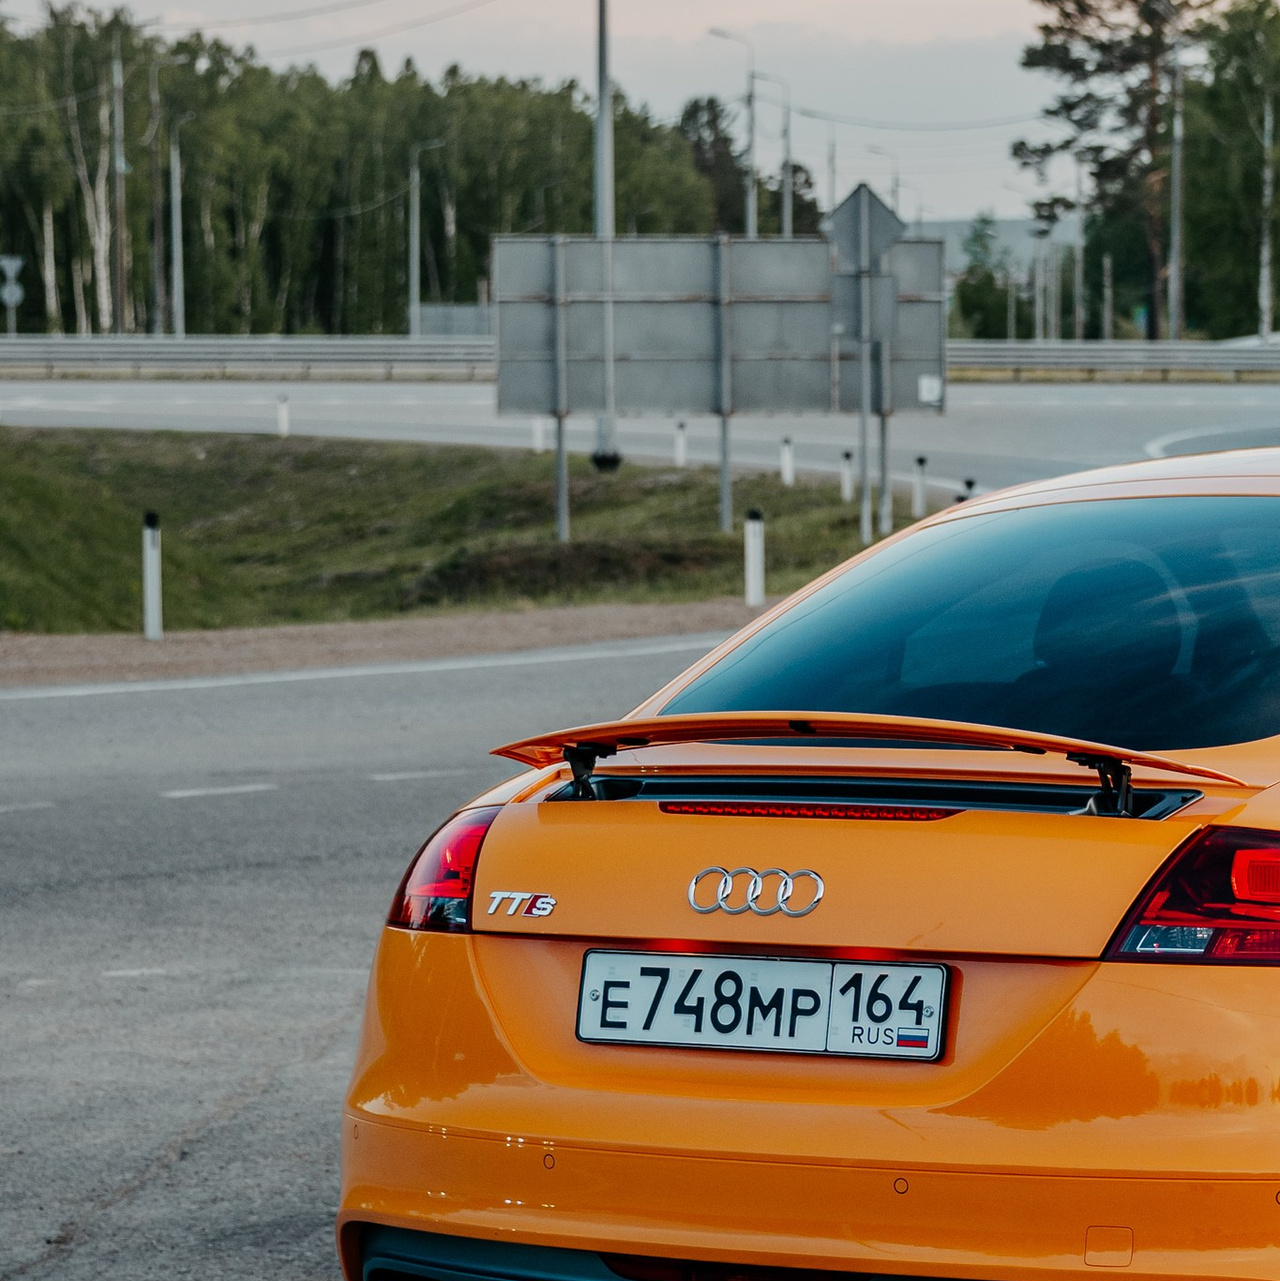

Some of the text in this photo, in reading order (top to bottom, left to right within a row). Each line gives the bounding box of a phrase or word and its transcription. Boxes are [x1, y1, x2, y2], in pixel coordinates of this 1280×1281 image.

[487, 891, 557, 917] TTS
[839, 972, 925, 1026] 164
[851, 1026, 894, 1046] RUS
